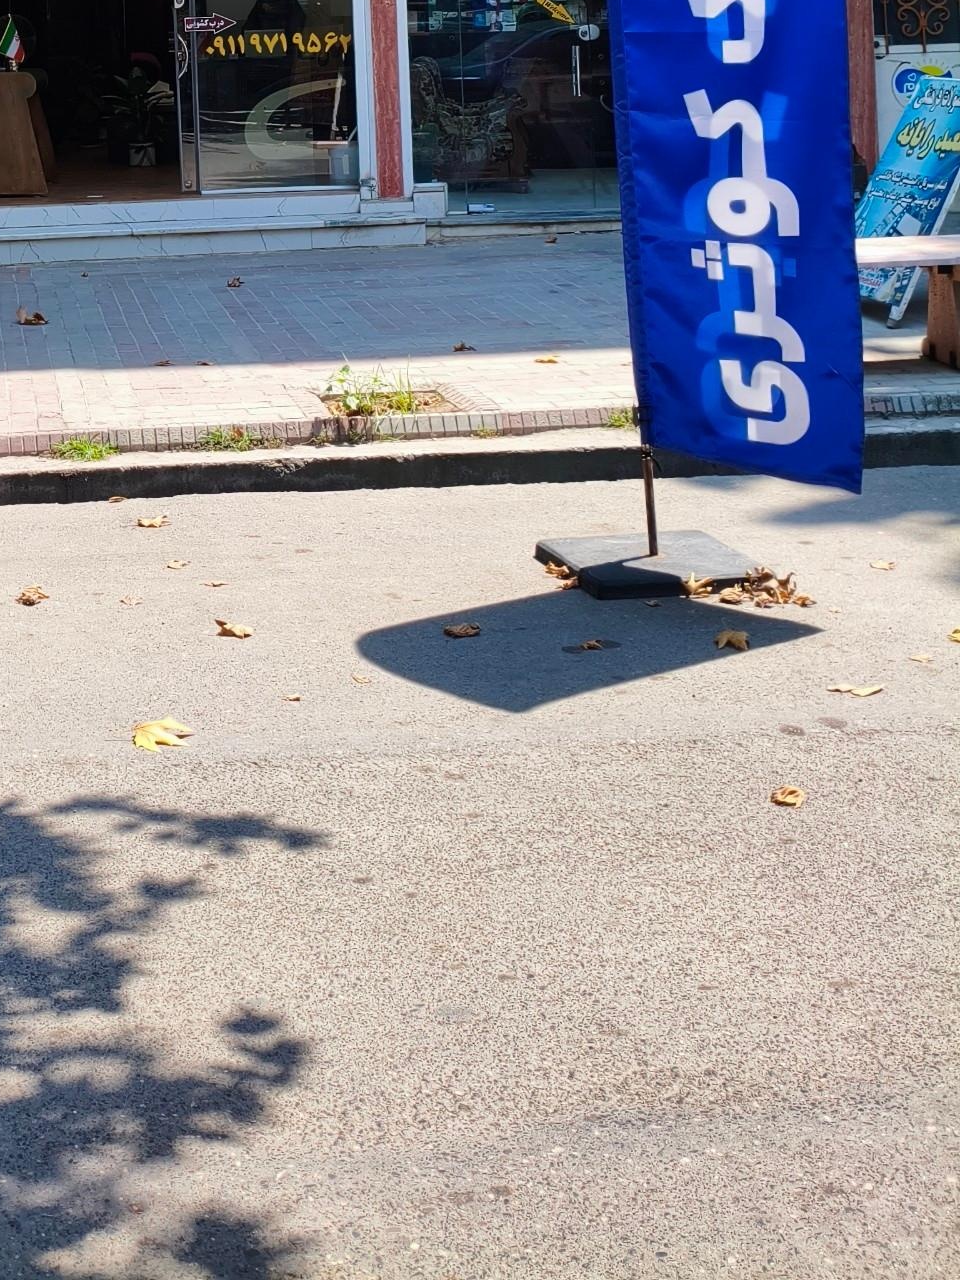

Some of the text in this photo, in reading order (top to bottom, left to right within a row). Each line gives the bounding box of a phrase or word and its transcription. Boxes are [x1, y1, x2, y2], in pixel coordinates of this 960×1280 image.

[206, 31, 352, 57] ۰۹۱۱ ۹۷۱ ۹۵۶۲
[683, 88, 811, 447] کوثری
